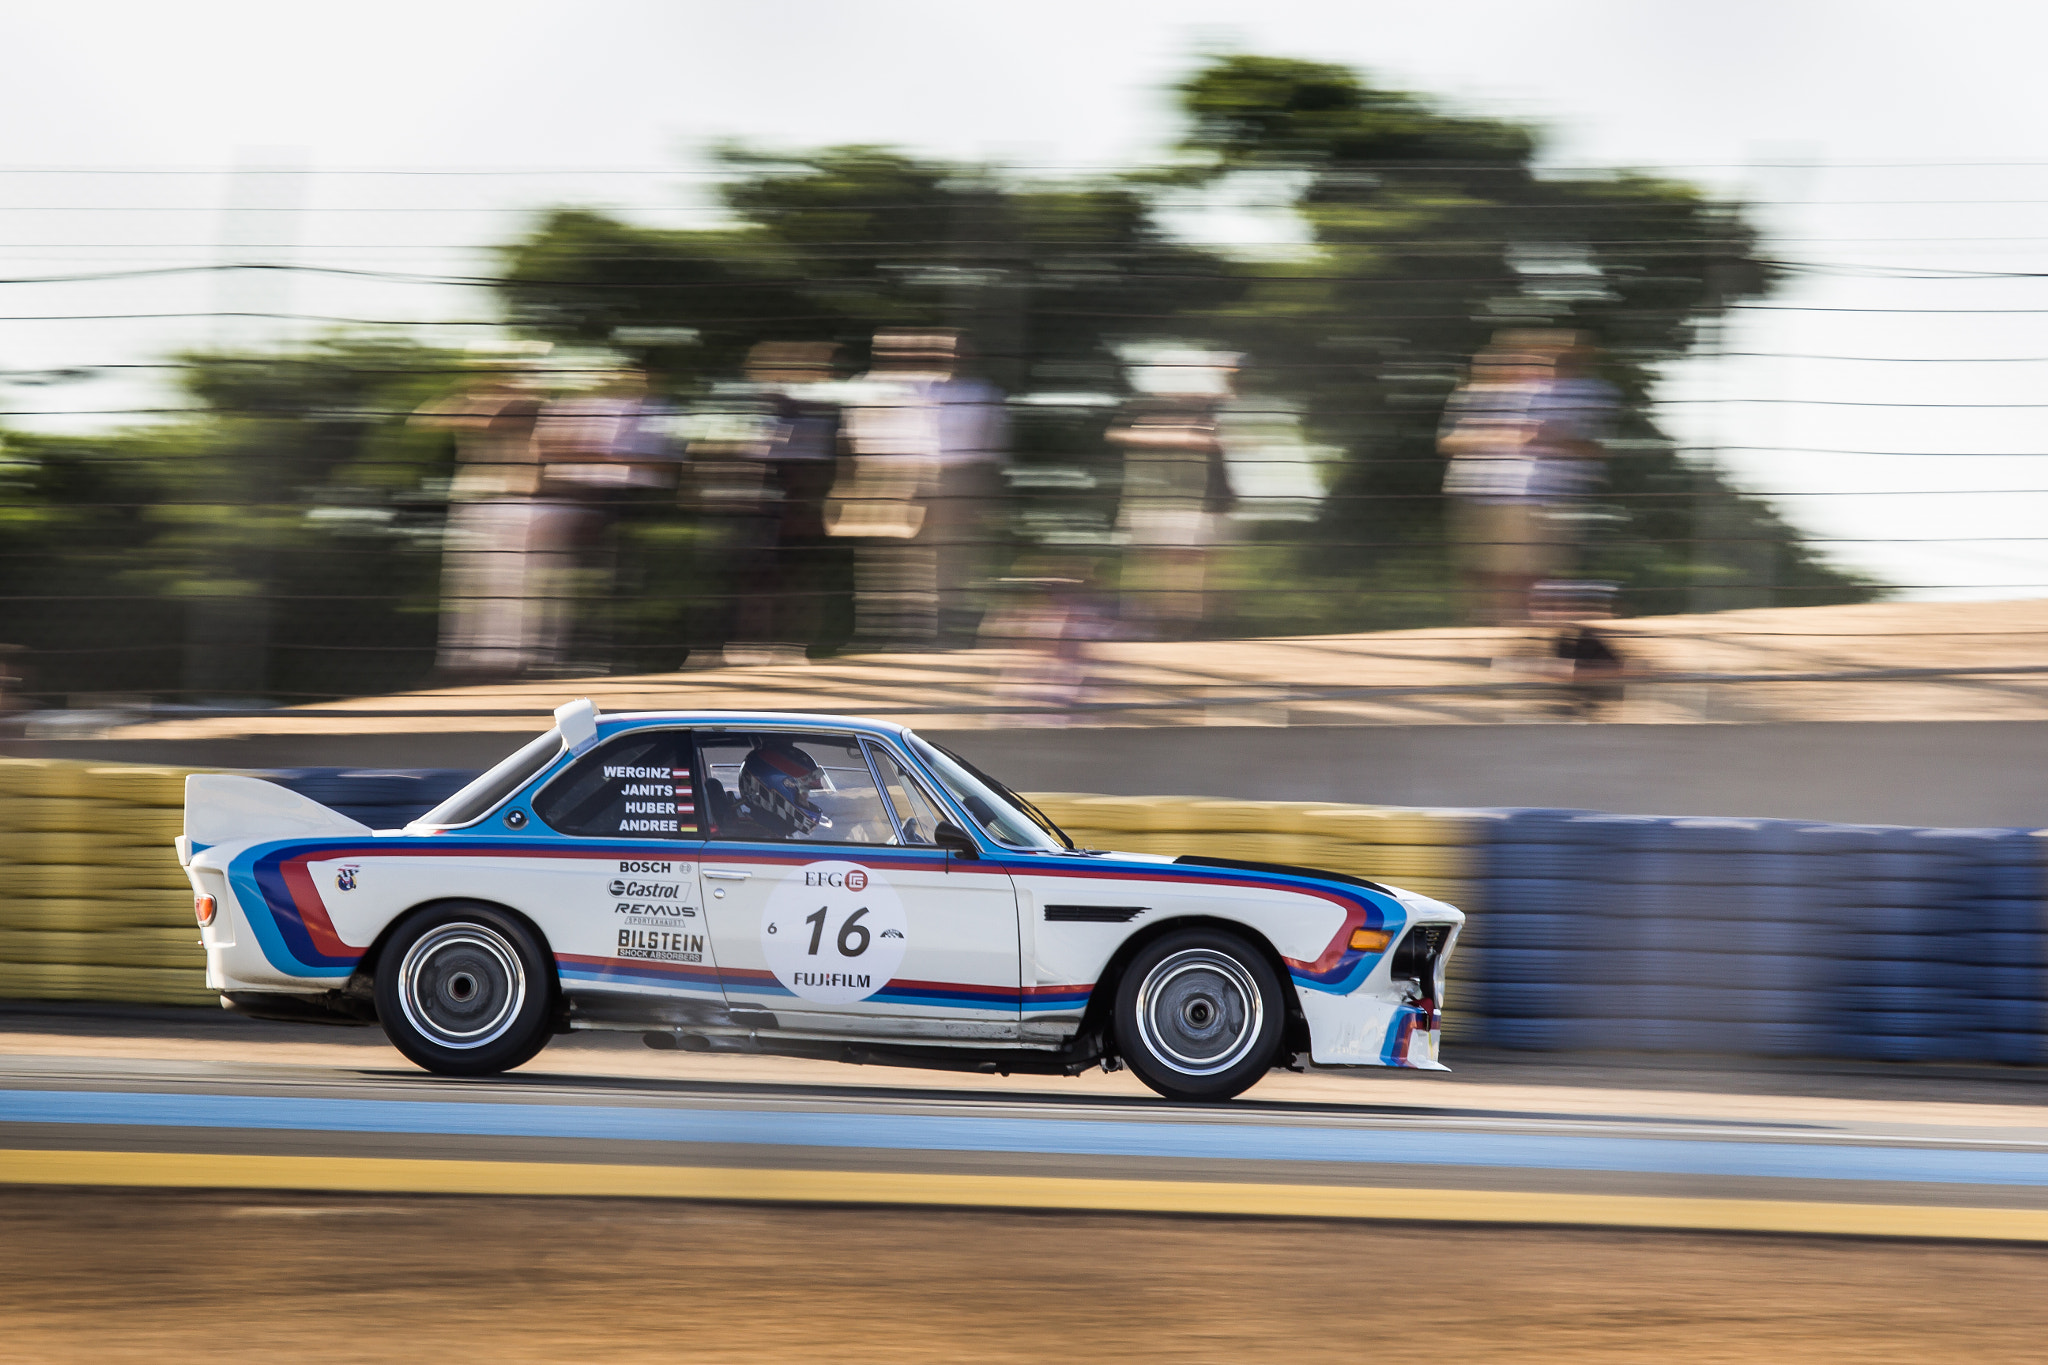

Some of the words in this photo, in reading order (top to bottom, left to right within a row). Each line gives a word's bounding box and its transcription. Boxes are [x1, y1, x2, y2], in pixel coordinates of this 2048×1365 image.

[603, 765, 671, 779] WERGINZ
[620, 784, 674, 797] JANITS
[625, 801, 676, 814] HUBER
[619, 819, 678, 832] ANDREE
[619, 861, 671, 873] BOSCH
[805, 871, 843, 887] EFG
[626, 881, 680, 899] Castrol
[614, 903, 696, 917] REMUS
[767, 922, 778, 935] 6
[805, 905, 871, 958] 16
[617, 929, 704, 953] BILSTEIN
[619, 948, 648, 958] SHOCK
[649, 951, 701, 962] ABSORBERS
[793, 972, 871, 988] FUJIFILM
